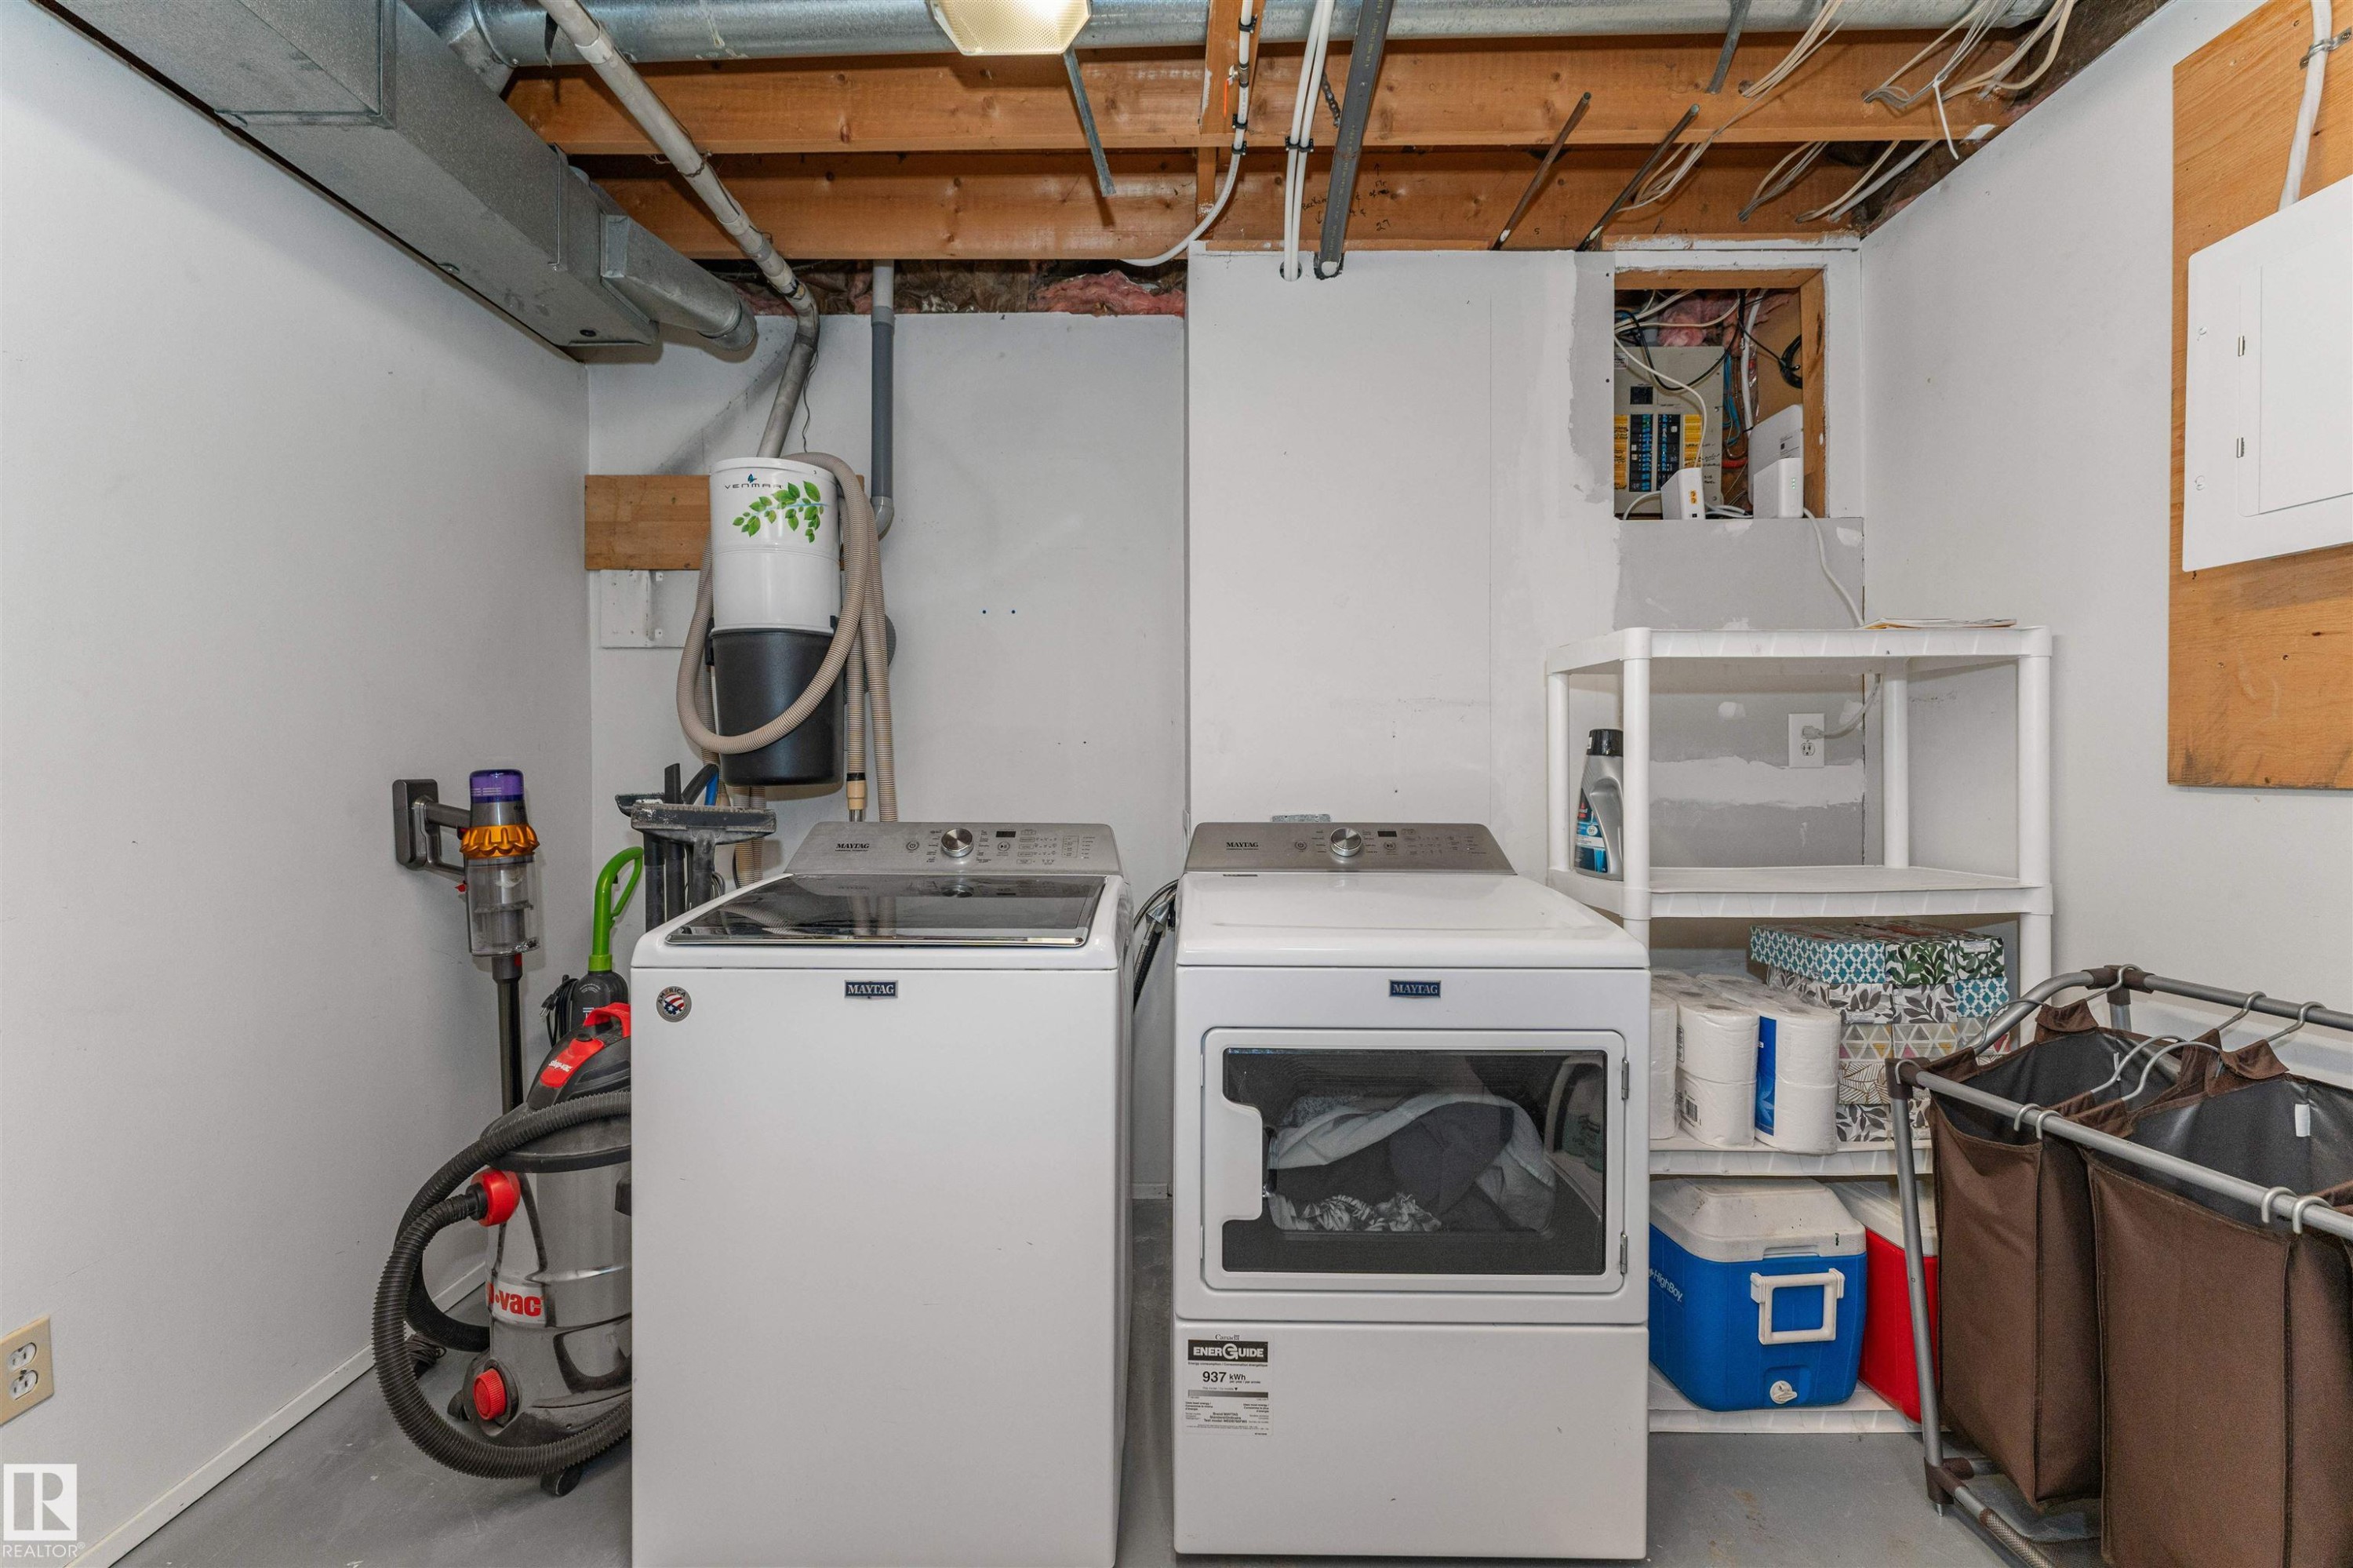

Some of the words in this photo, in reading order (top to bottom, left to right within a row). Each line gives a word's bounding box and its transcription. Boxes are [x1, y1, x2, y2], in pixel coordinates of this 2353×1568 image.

[848, 984, 895, 995] MAYTAG
[1392, 984, 1438, 995] MAYTAG
[657, 988, 686, 1004] AMERICA
[1193, 1343, 1264, 1360] ENERGUIDE
[1202, 1371, 1227, 1383] 937
